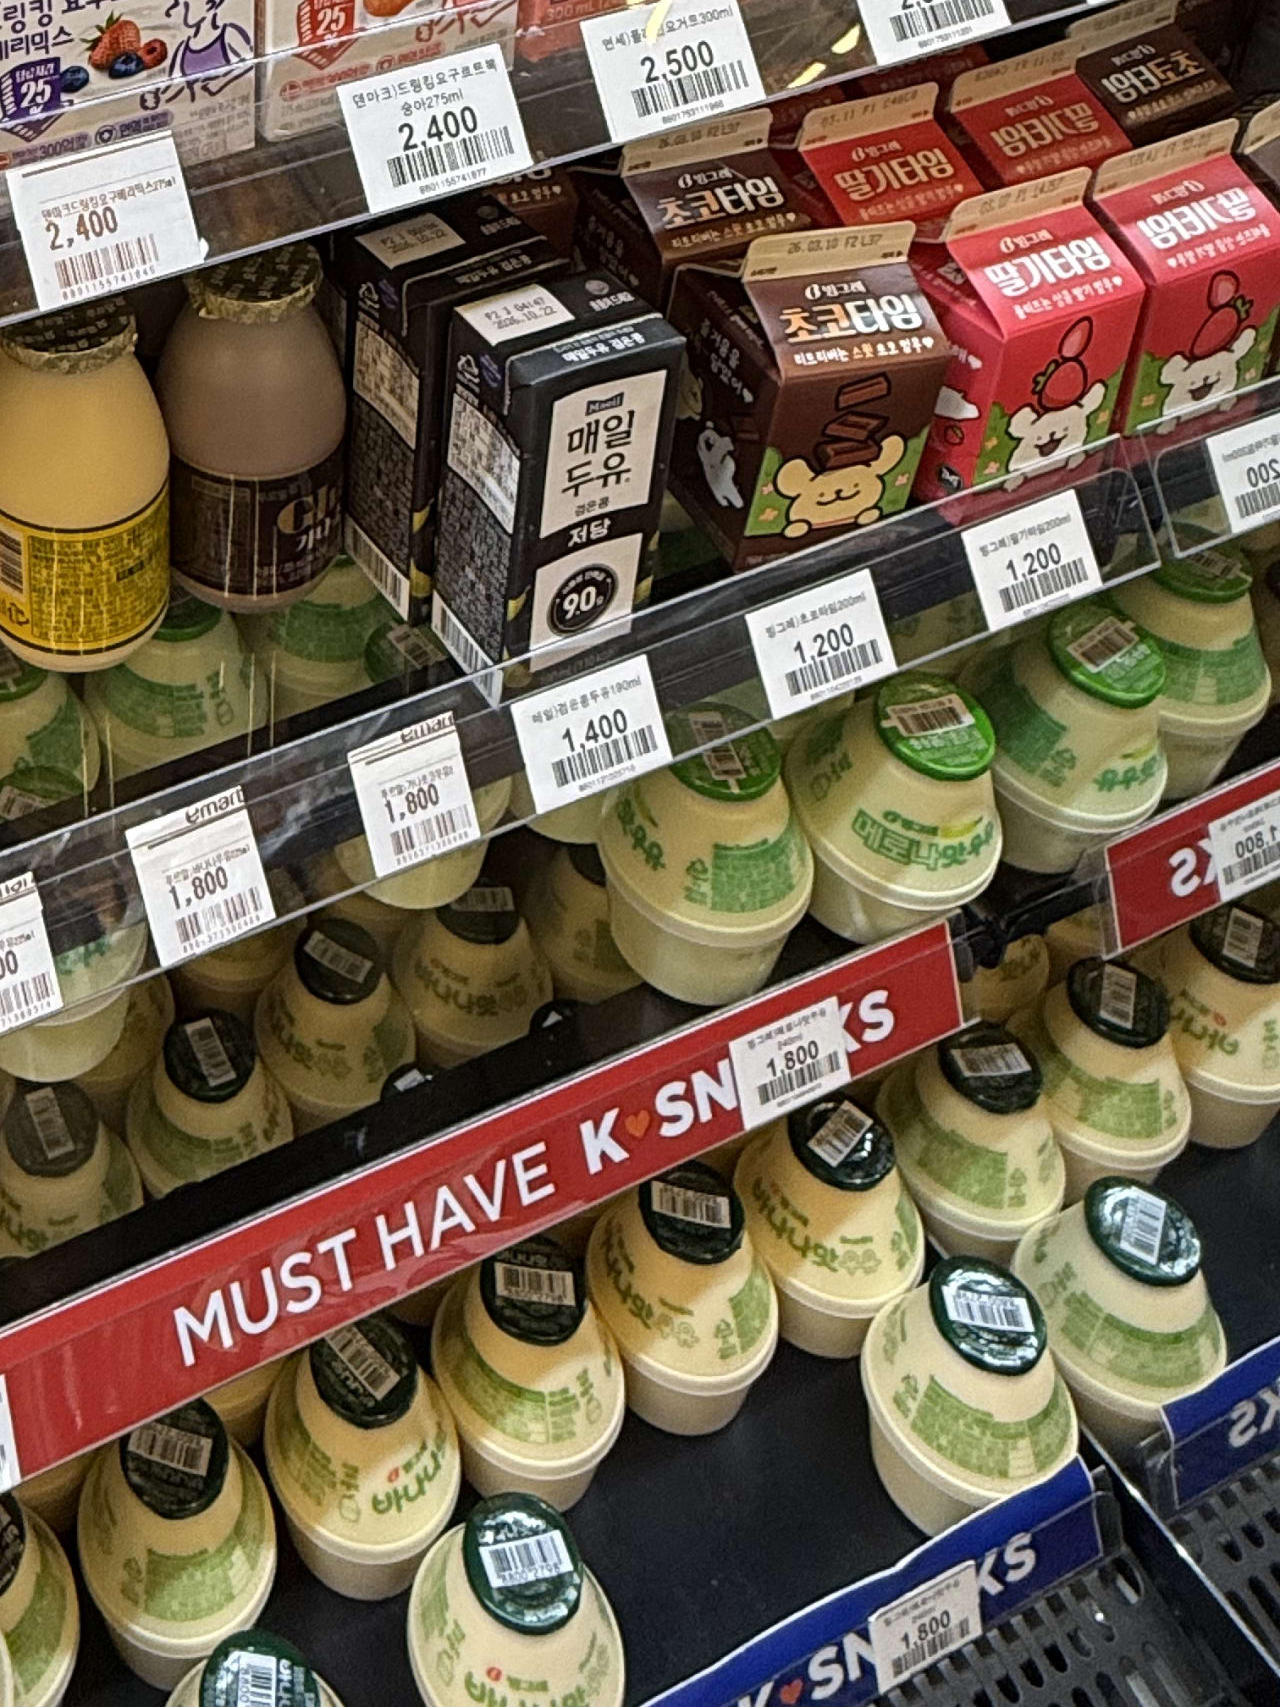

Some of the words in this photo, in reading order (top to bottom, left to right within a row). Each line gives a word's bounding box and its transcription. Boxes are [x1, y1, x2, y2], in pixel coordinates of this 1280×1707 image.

[352, 57, 497, 108] 덴마크)드링킹요구르트복
[640, 40, 714, 83] 2,500
[400, 88, 464, 114] 숭아275ml
[398, 105, 478, 152] 2,400
[657, 177, 786, 227] 초코타임
[45, 206, 118, 250] 2,400
[781, 296, 924, 344] 초코타임
[568, 518, 611, 547] 저당
[1006, 543, 1062, 582] 1,200
[793, 624, 855, 664] 1,200
[561, 709, 628, 752] 1,400
[384, 785, 439, 824] 1,800
[169, 867, 229, 910] 1,800
[766, 1041, 821, 1077] 1,800
[175, 1229, 356, 1365] MUST
[375, 1143, 557, 1271] HAVE
